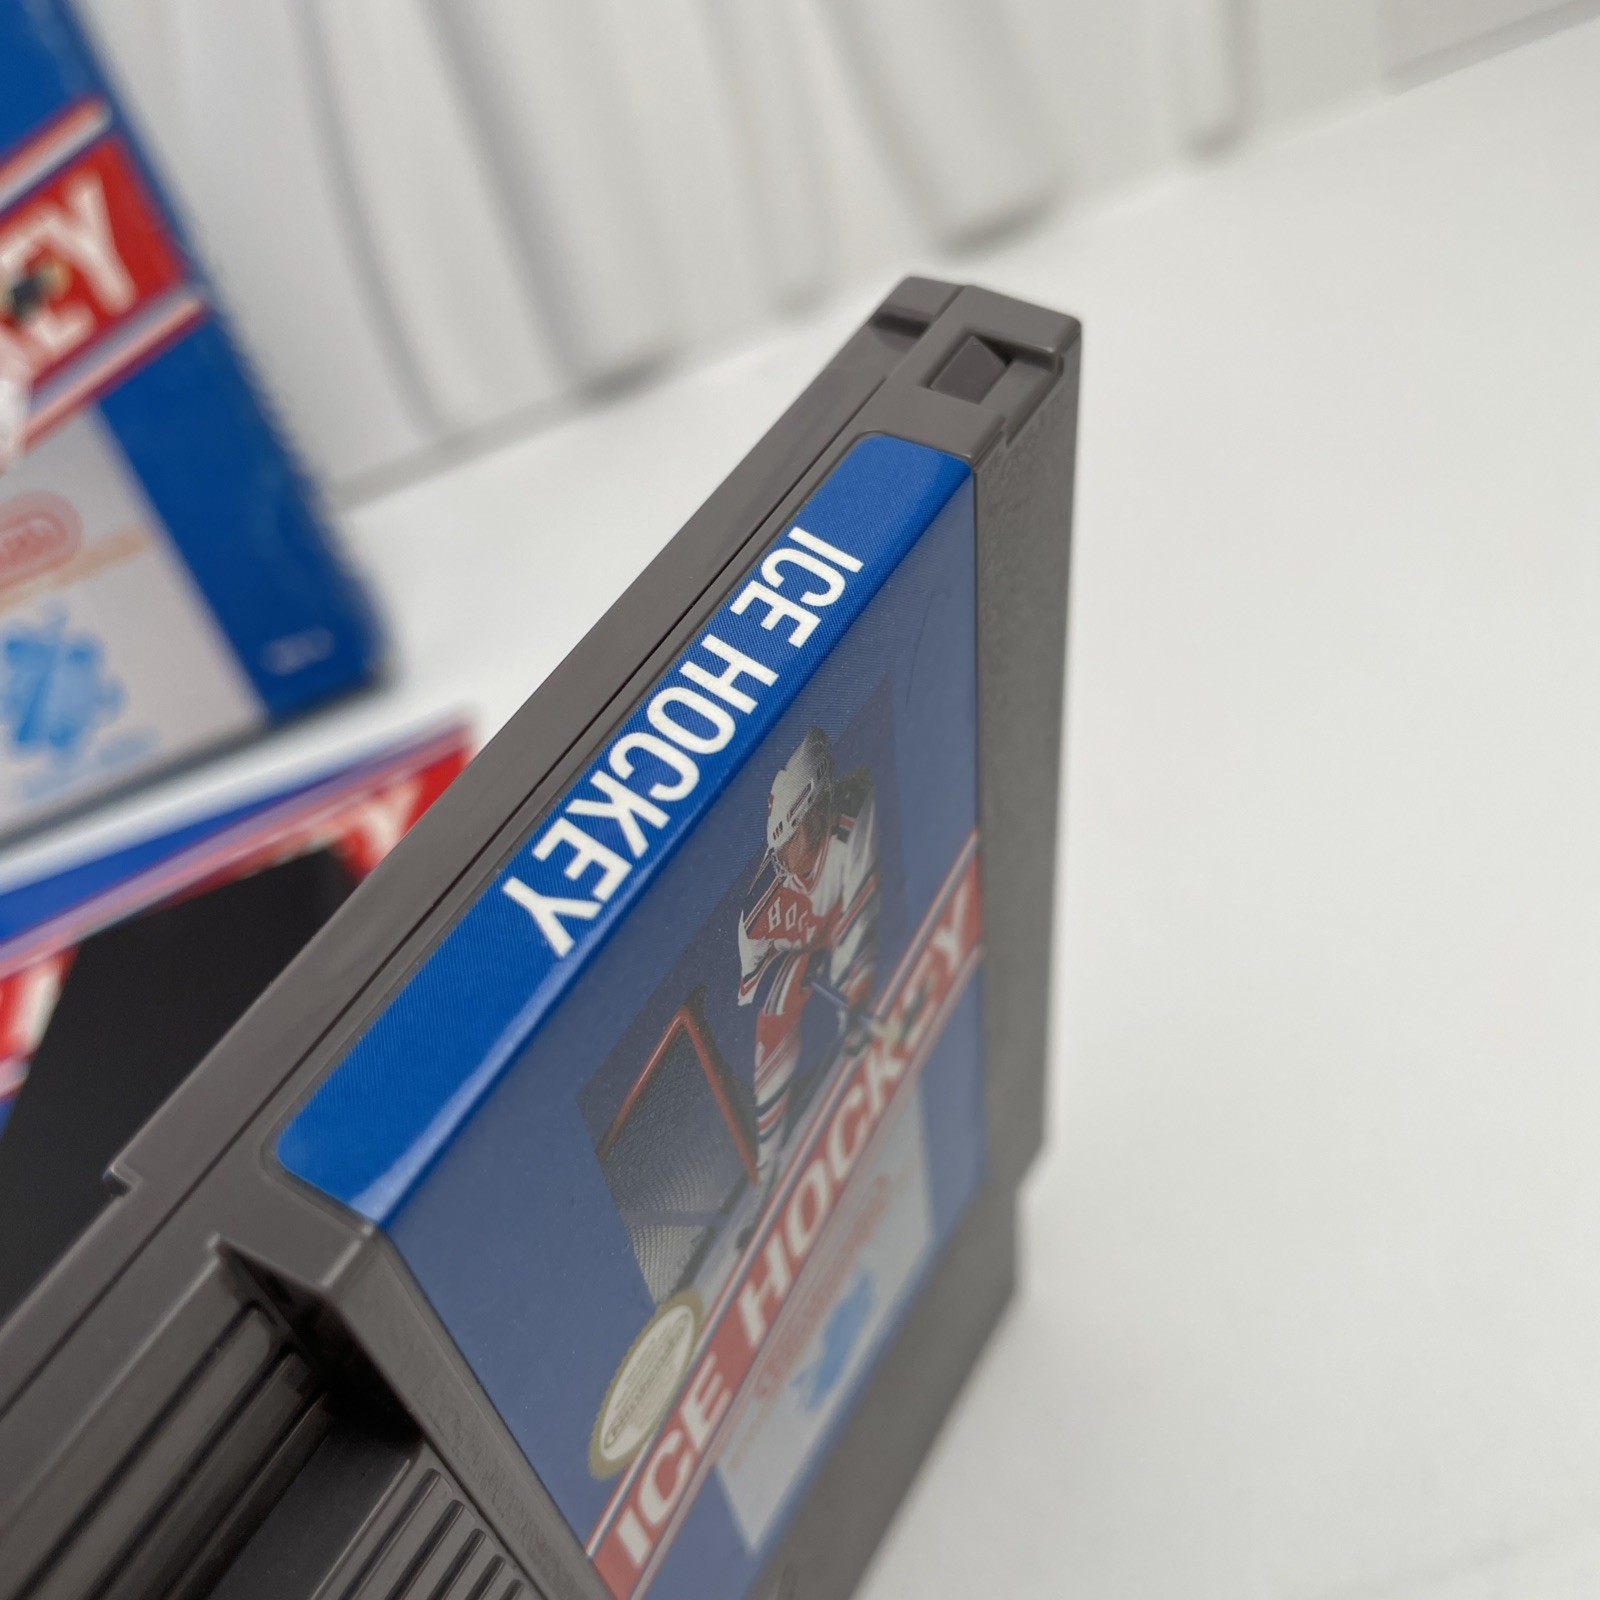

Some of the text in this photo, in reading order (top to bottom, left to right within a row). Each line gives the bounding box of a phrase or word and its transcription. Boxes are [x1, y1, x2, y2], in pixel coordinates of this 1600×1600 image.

[501, 526, 864, 958] ICE HOCKEY
[615, 1351, 733, 1566] ICE
